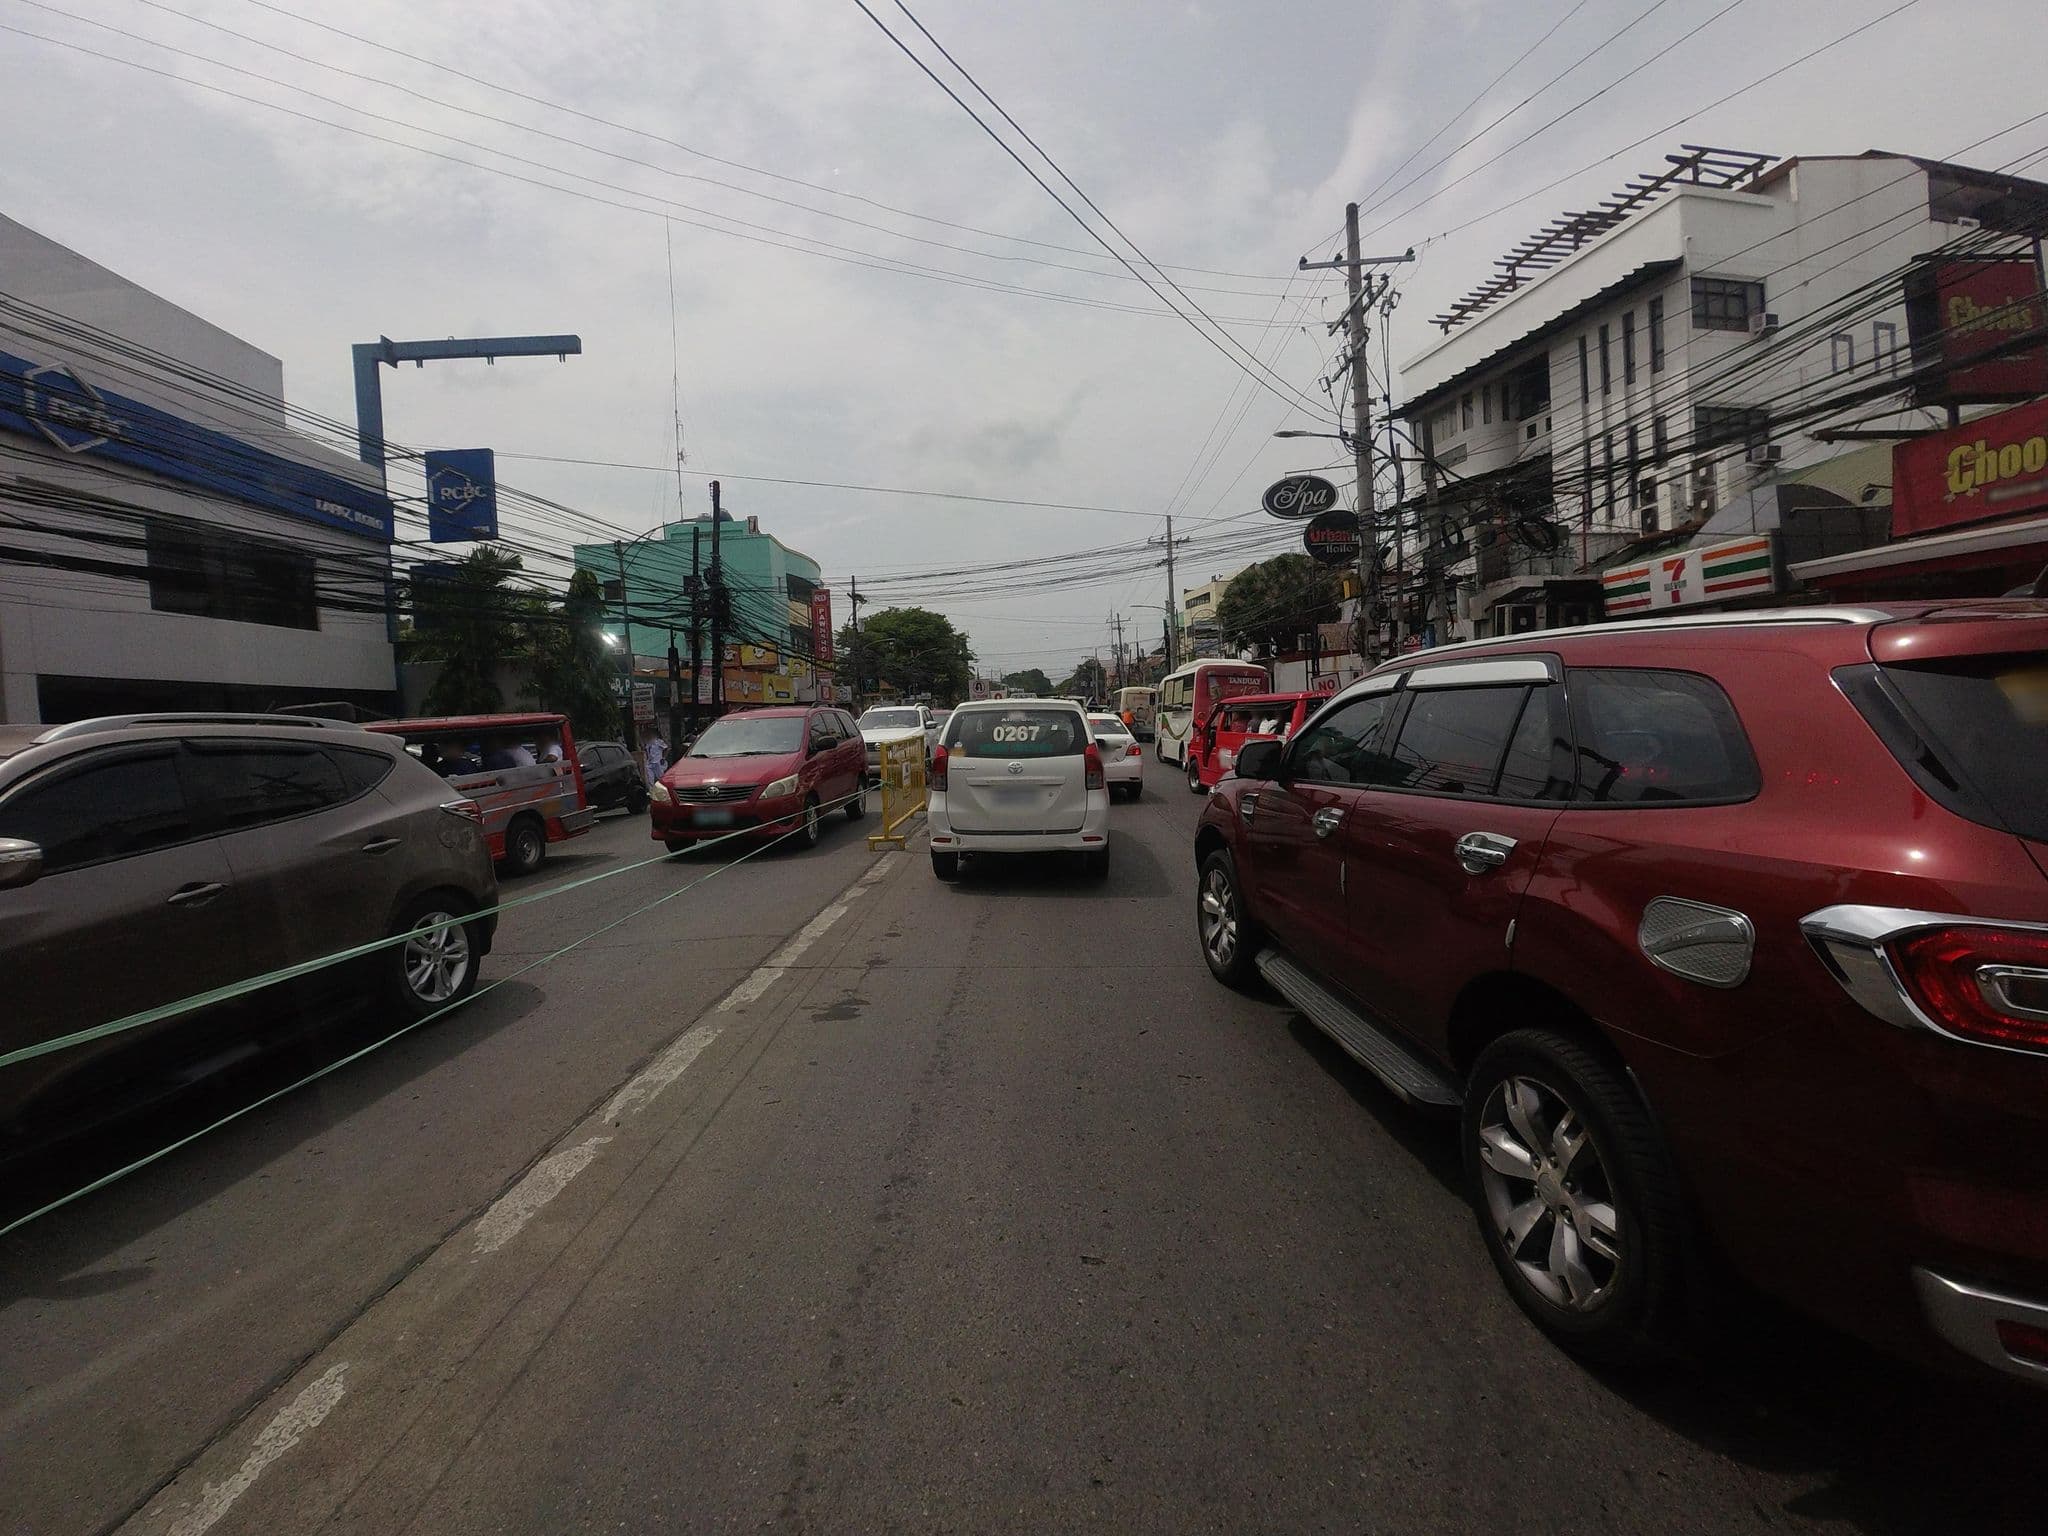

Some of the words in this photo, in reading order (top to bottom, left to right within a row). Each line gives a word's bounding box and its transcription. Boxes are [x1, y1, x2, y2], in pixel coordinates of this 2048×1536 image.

[440, 486, 487, 500] RCBC
[1273, 479, 1328, 514] Spa
[1663, 558, 1686, 603] 7
[1228, 676, 1261, 685] TANDUAY
[1317, 679, 1335, 691] NO
[993, 725, 1040, 742] 0267
